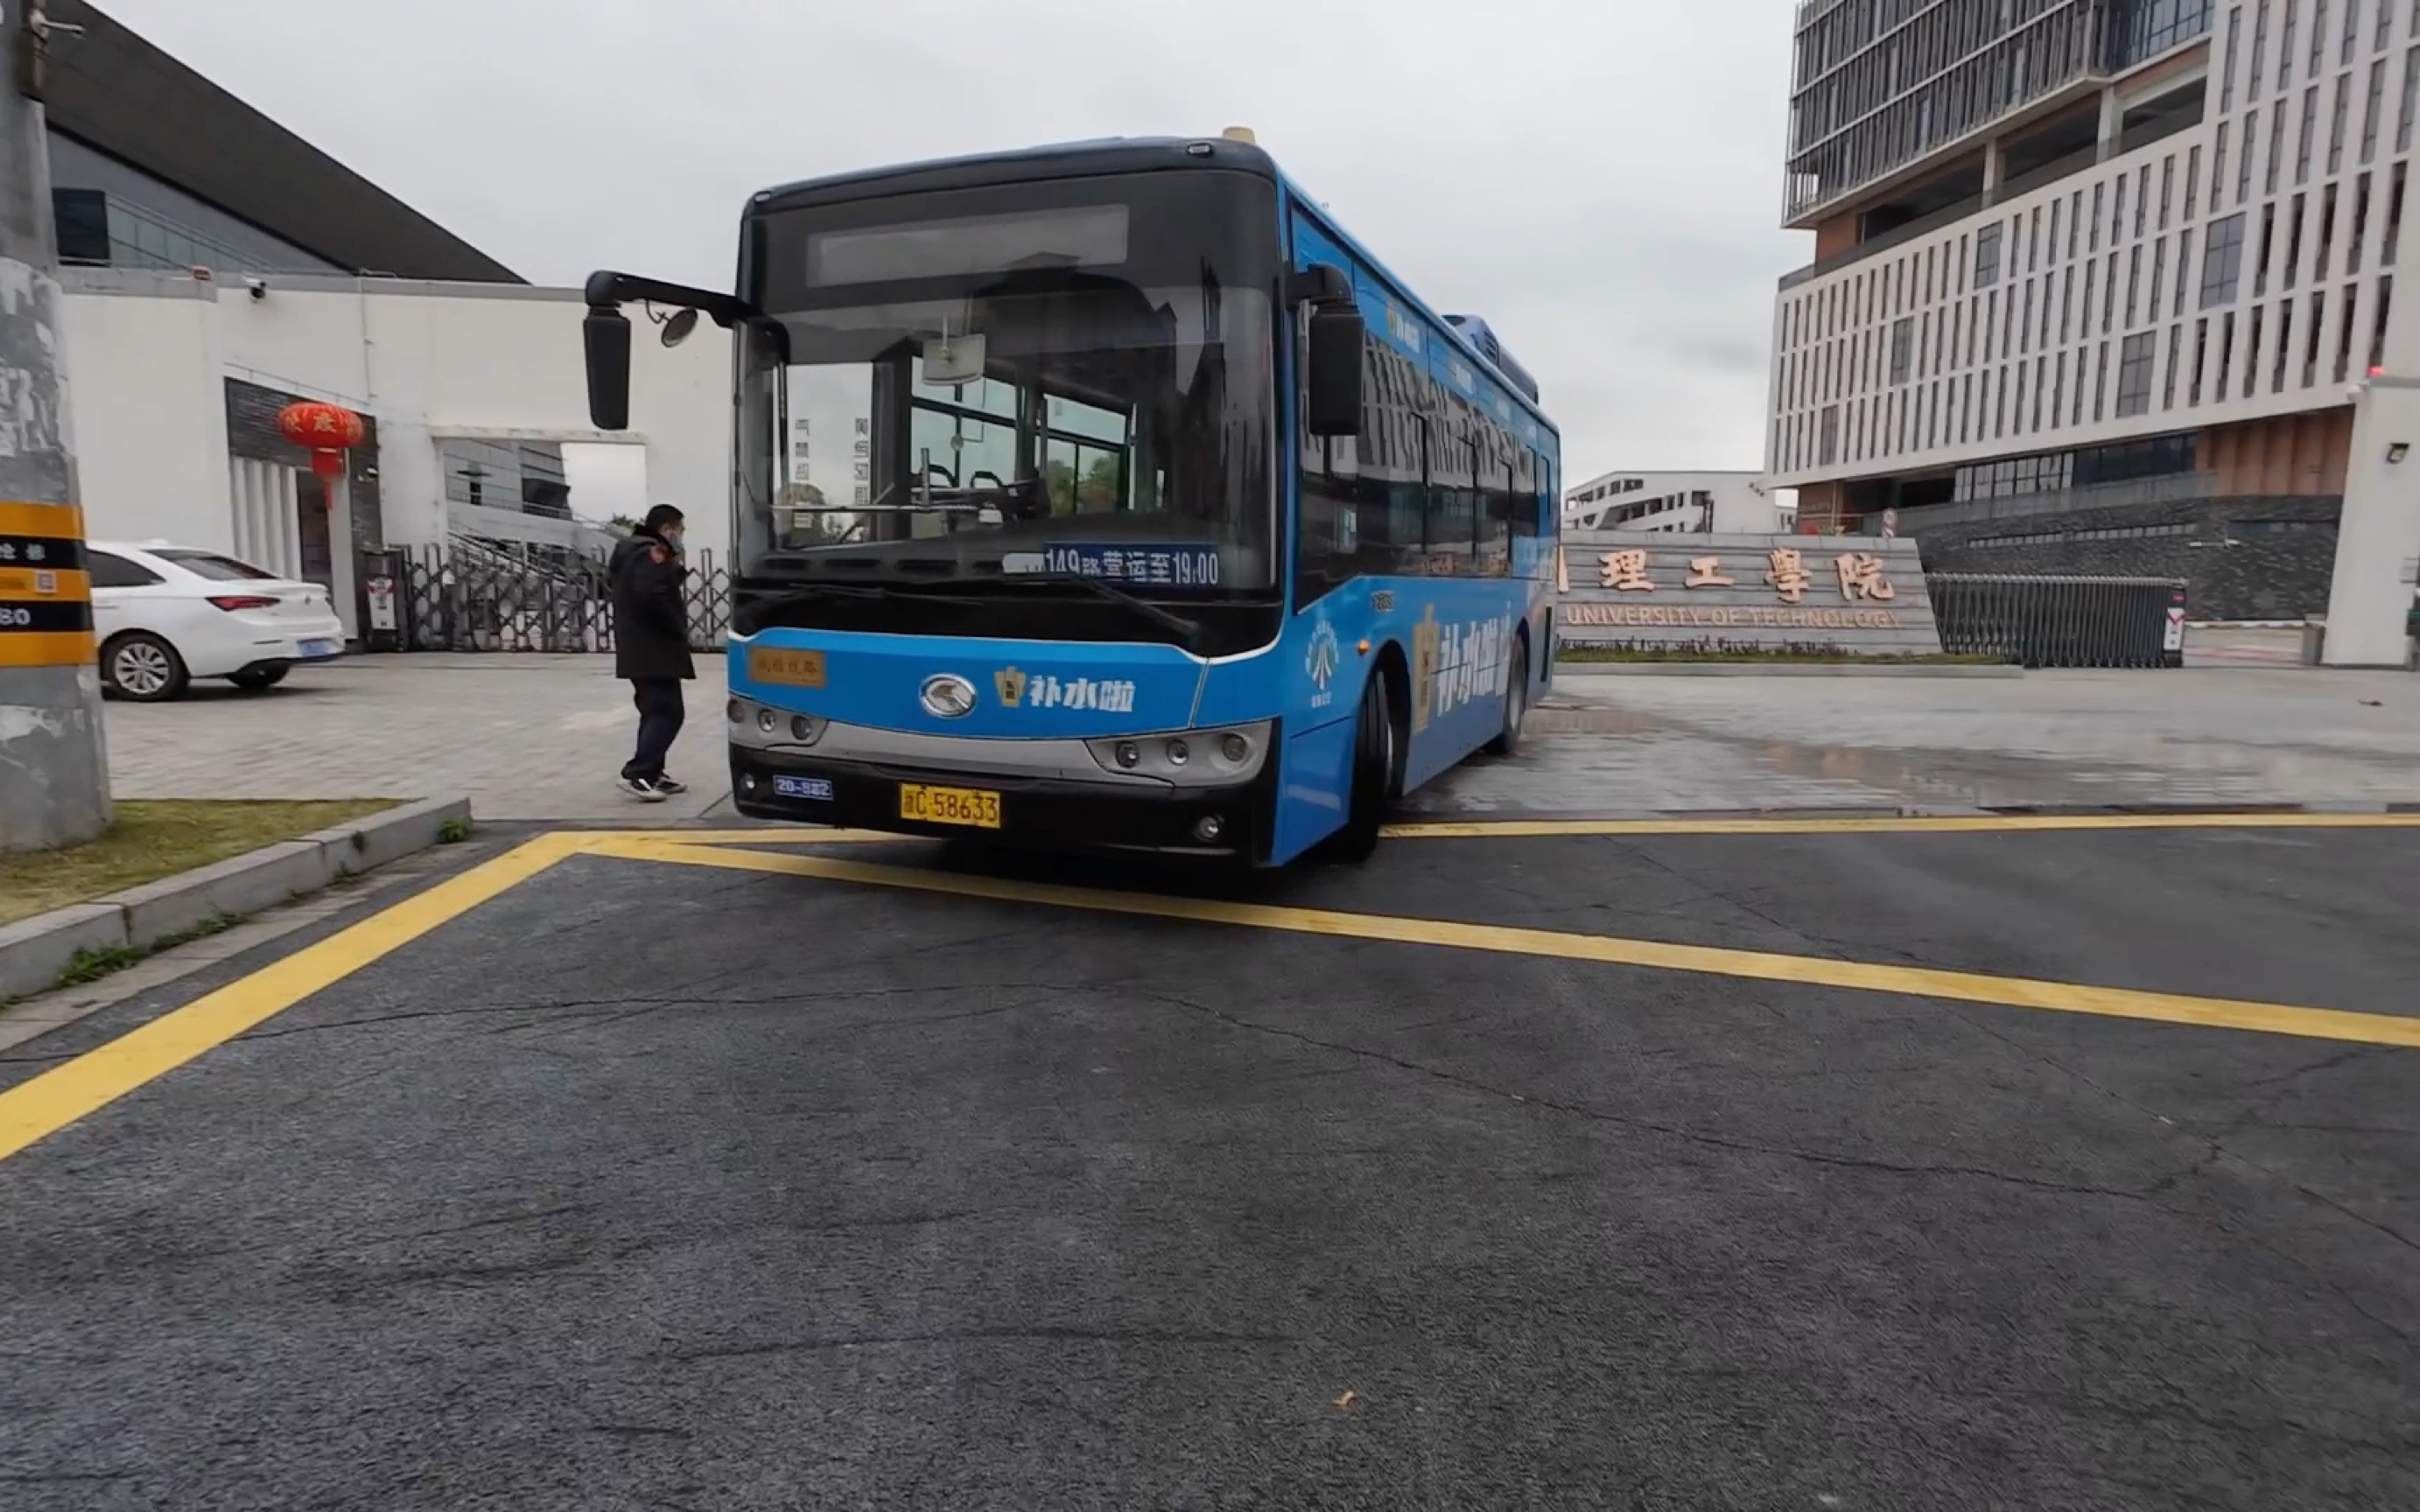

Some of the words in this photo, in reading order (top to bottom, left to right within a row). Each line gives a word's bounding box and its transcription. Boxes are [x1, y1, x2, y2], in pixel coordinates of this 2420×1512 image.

[1557, 545, 1894, 602] 理工學院
[1567, 606, 1700, 626] UNIVERSITY
[1711, 609, 1741, 626] OF
[1029, 675, 1136, 712] 补水啦
